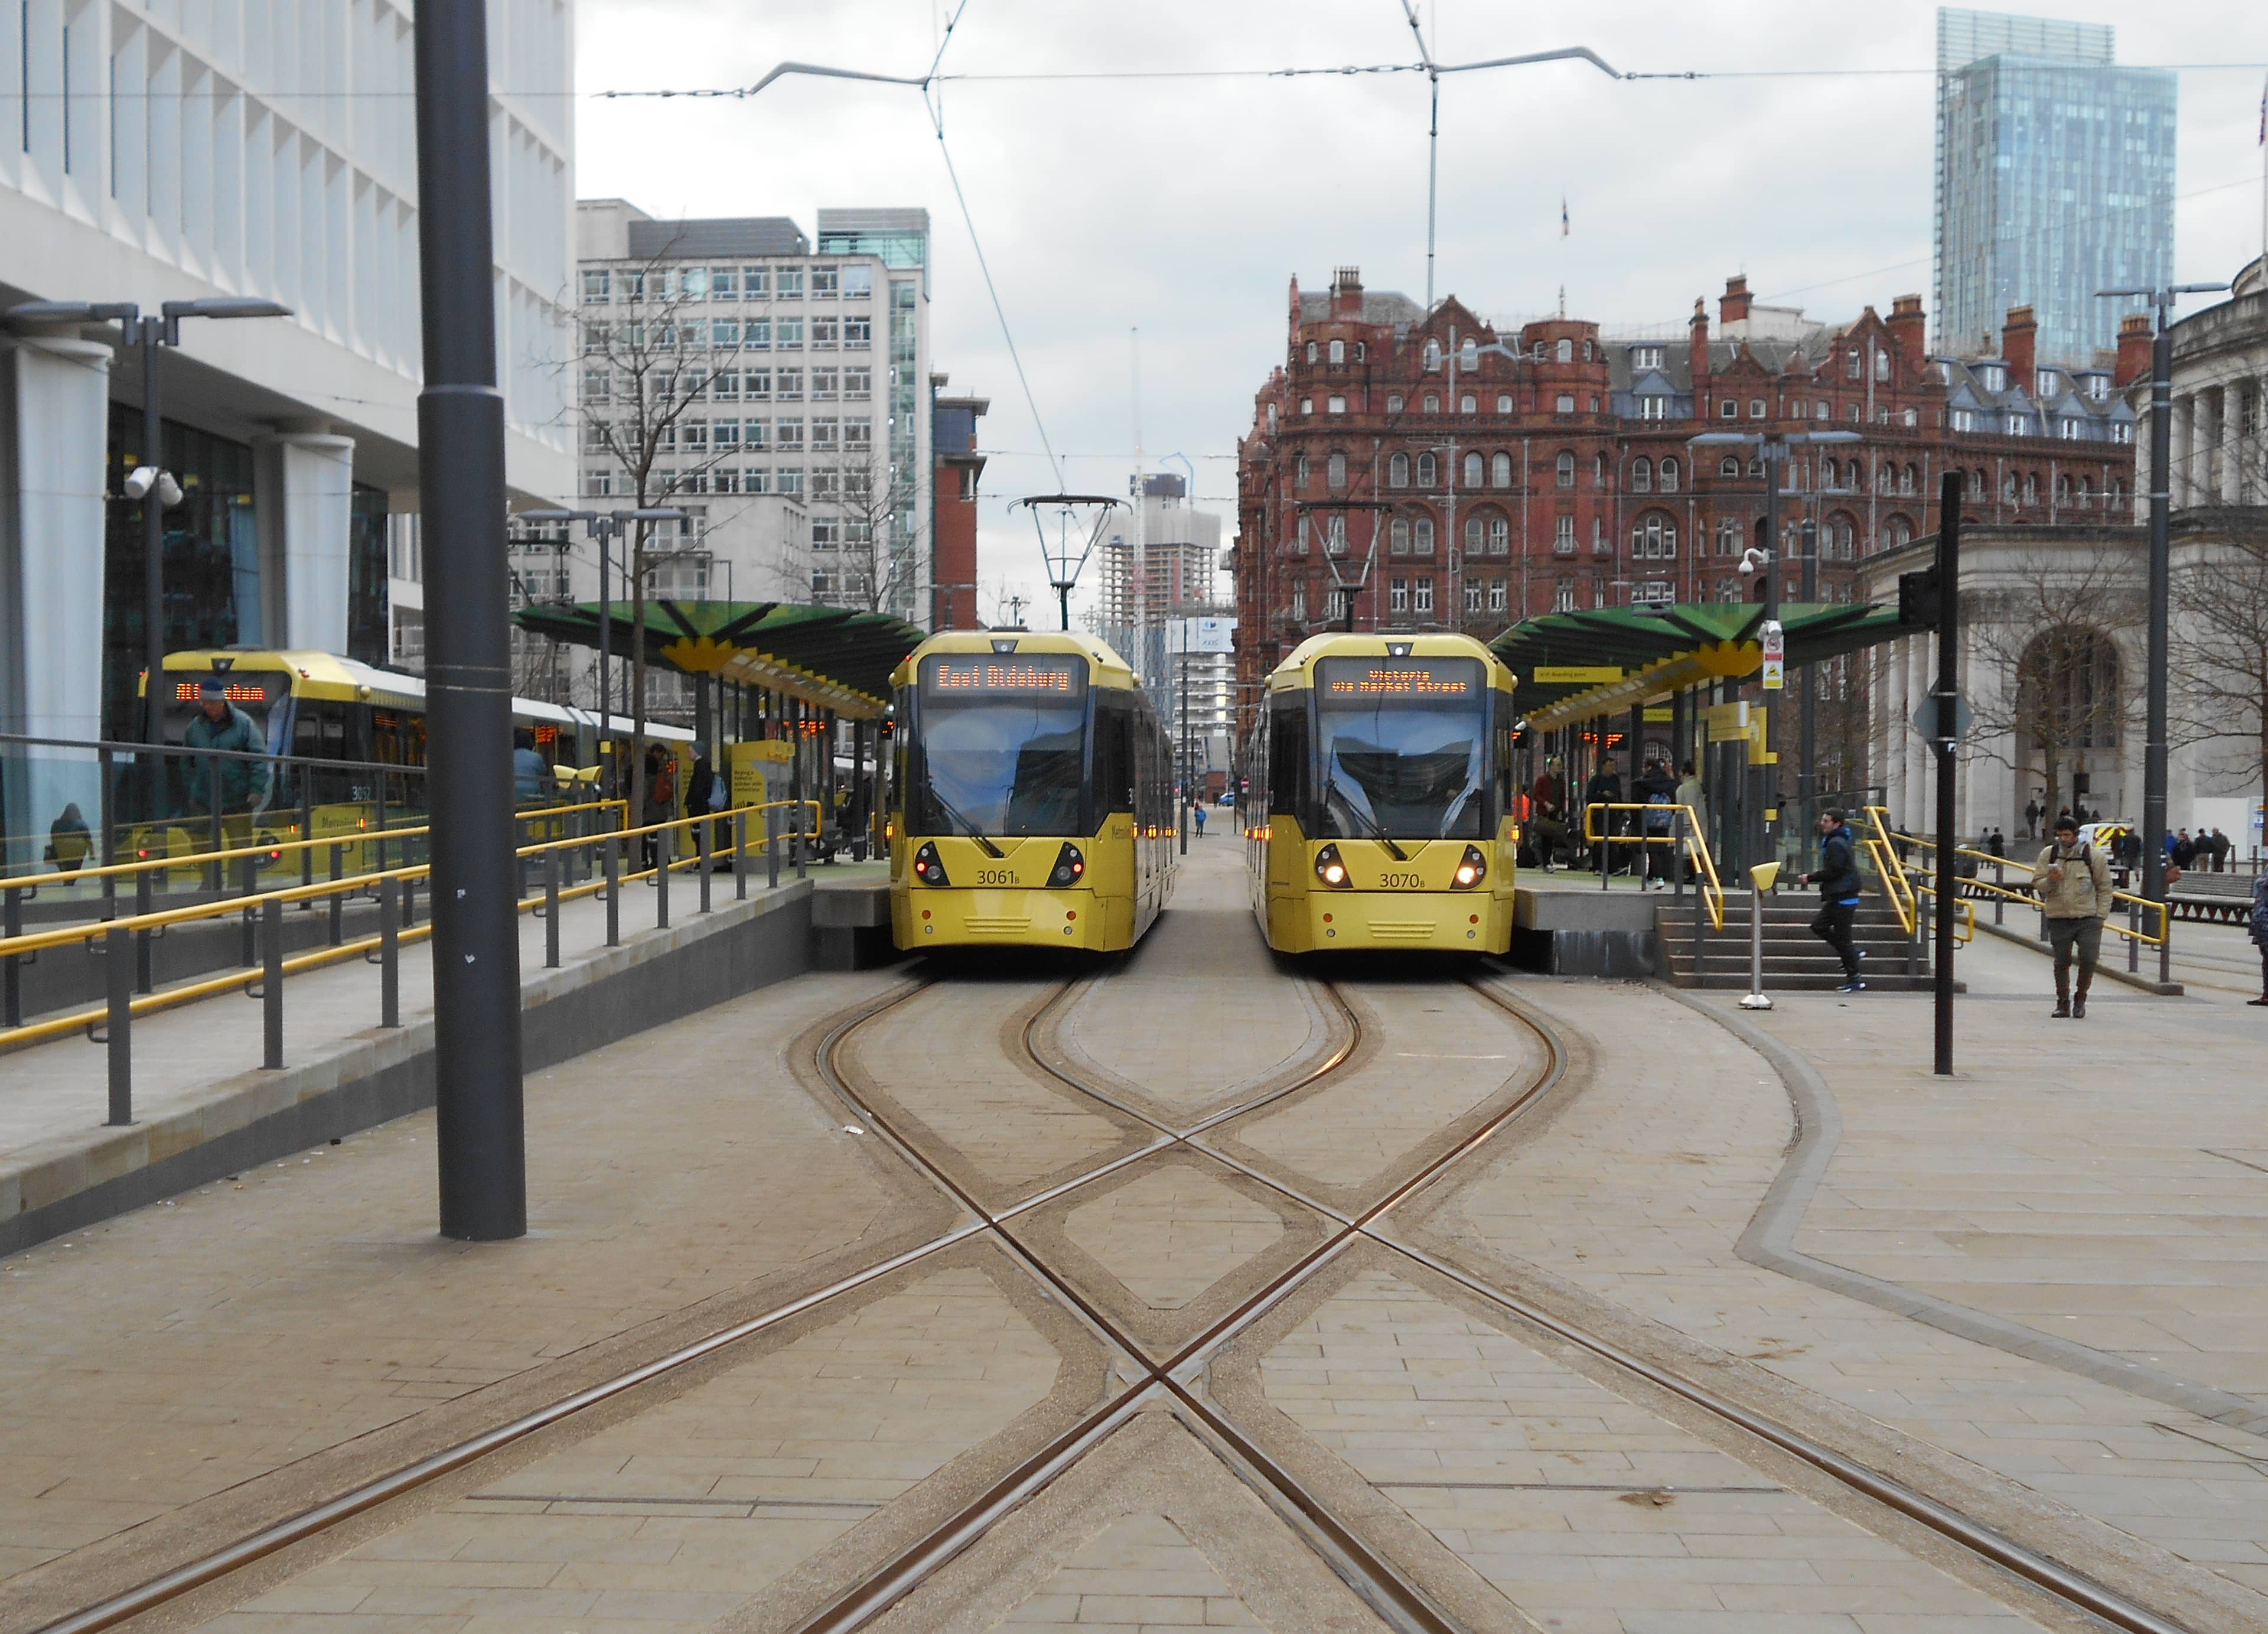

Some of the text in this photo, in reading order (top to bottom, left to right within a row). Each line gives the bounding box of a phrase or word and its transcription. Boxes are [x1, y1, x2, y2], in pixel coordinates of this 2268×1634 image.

[939, 665, 1068, 691] East Didsbury
[1368, 670, 1430, 681] Victoria
[1331, 681, 1467, 692] via Market Street
